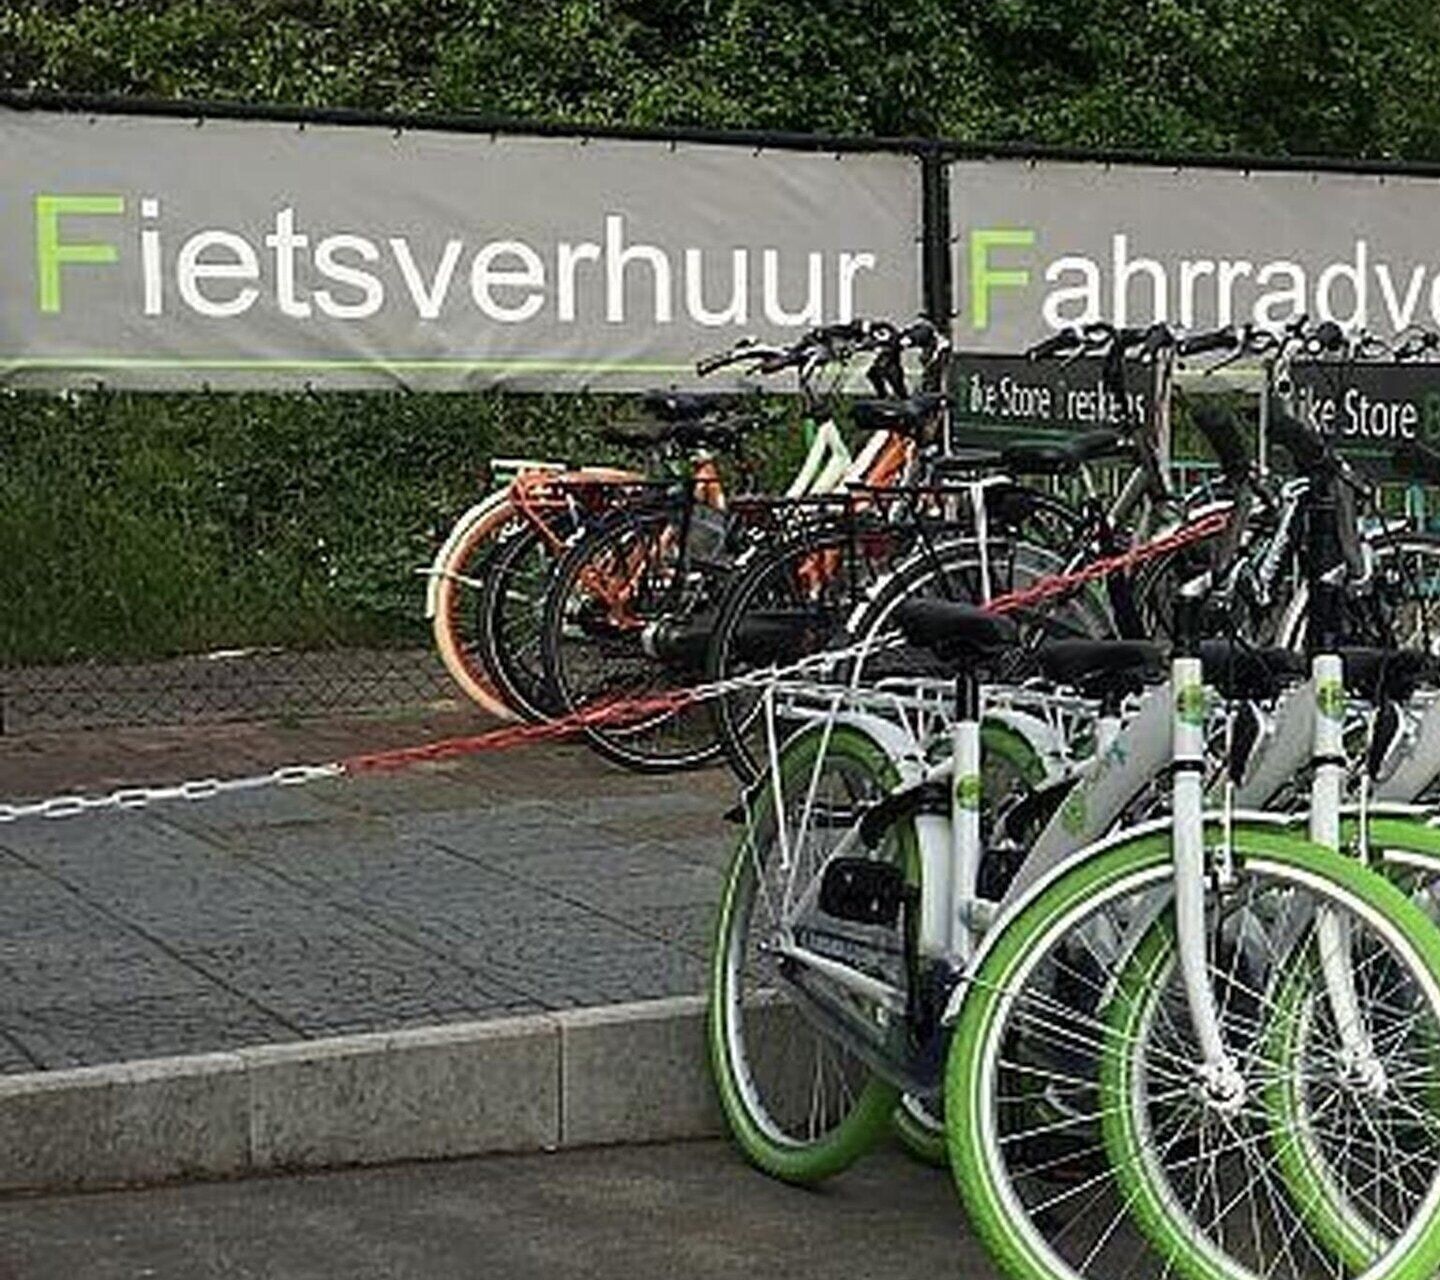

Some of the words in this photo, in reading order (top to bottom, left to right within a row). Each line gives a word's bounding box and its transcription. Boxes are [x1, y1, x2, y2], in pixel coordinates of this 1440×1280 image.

[33, 194, 875, 327] Fietsverhuur
[999, 375, 1051, 420] Store
[1056, 379, 1145, 424] reskes
[1296, 387, 1336, 434] ike
[1344, 388, 1418, 439] Store
